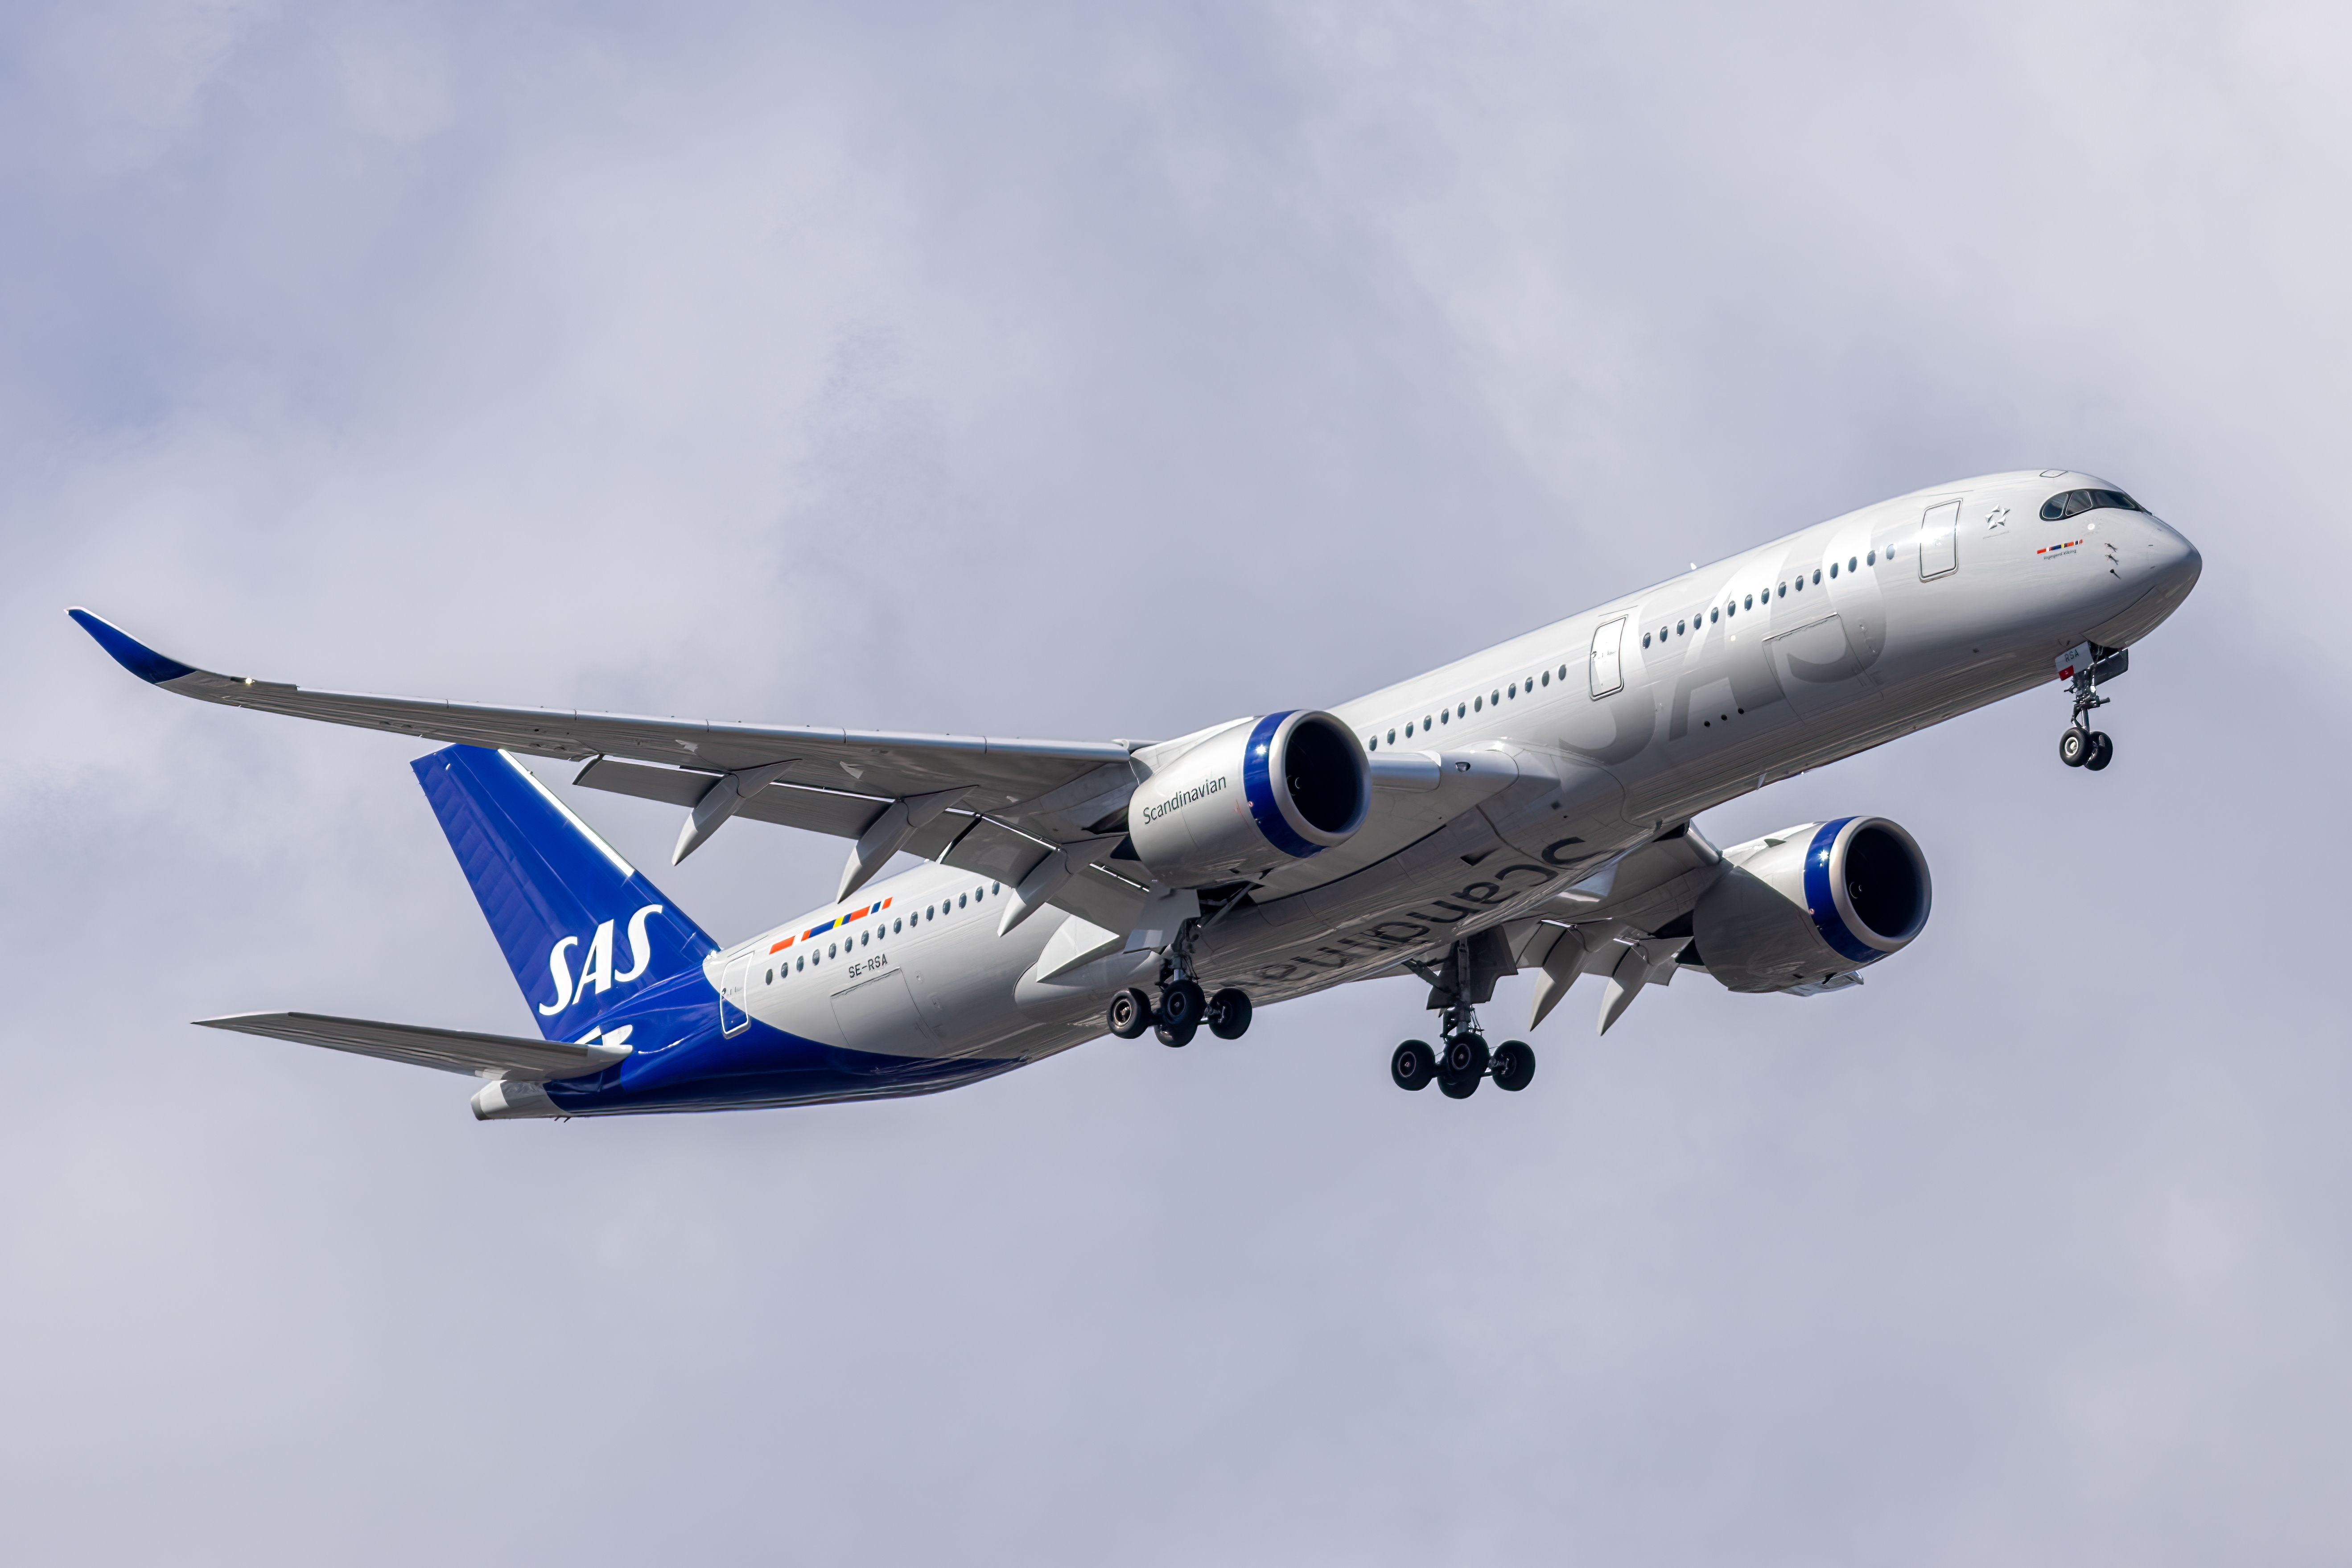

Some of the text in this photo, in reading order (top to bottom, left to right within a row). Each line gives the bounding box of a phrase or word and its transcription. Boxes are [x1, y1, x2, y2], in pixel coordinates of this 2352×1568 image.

[2064, 649, 2080, 663] RSA
[1143, 776, 1227, 825] Scandinavian
[539, 904, 663, 1016] SAS
[849, 953, 888, 978] SE-RSA
